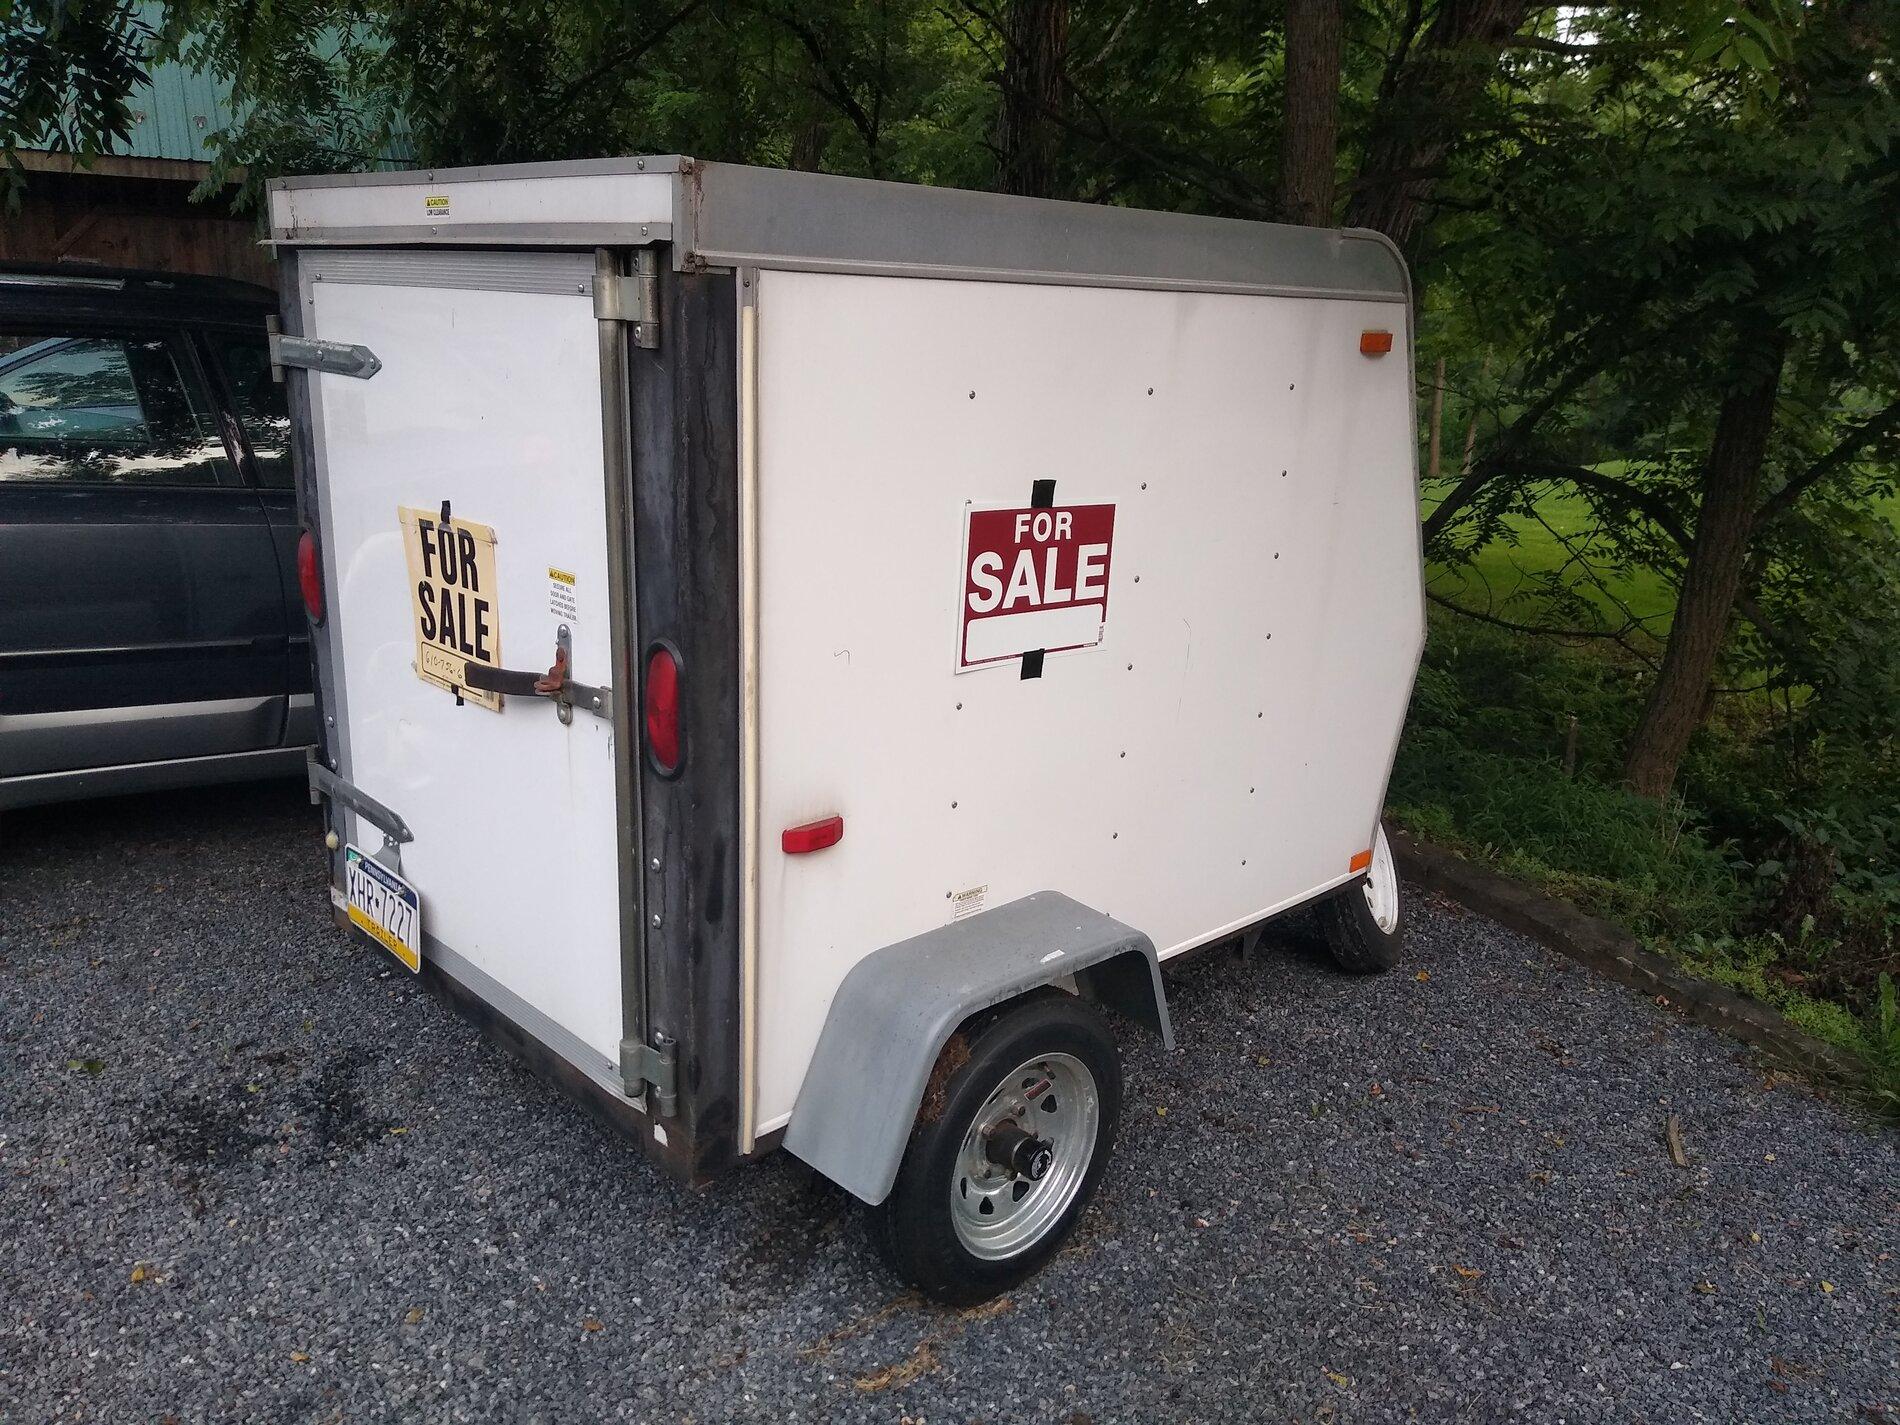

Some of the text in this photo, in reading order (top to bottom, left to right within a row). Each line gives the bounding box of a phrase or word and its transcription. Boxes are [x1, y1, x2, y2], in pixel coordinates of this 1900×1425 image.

[1014, 511, 1073, 543] FOR
[418, 518, 479, 593] FOR
[553, 571, 576, 585] CAUTION
[968, 543, 1108, 613] SALE
[418, 580, 491, 663] SALE
[366, 917, 399, 949] TRAILER
